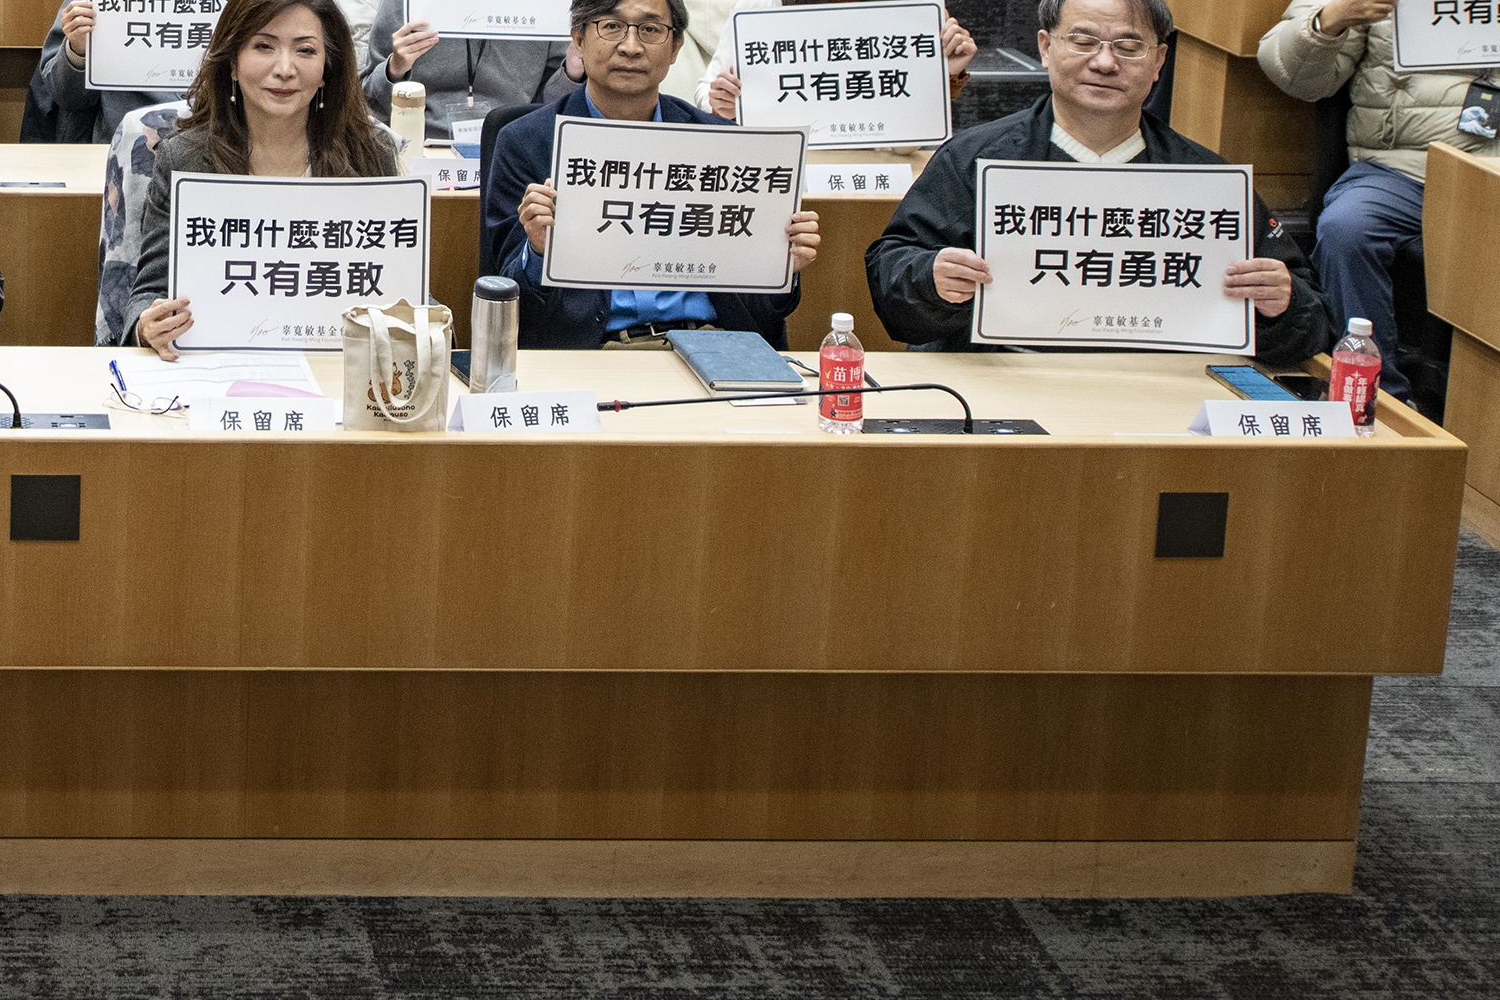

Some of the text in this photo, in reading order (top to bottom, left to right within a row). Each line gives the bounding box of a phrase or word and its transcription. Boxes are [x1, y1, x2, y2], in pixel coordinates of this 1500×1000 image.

[124, 22, 215, 52] 只有勇
[745, 34, 935, 65] 我們什麼都沒有
[778, 70, 910, 102] 只有勇敢
[566, 158, 793, 194] 我們什麼都沒有
[828, 174, 889, 190] 保留席
[186, 217, 418, 249] 我們什麼都沒有
[597, 200, 755, 237] 只有勇敢
[994, 204, 1239, 240] 我們什麼都沒有
[221, 260, 383, 297] 只有勇敢
[1030, 249, 1202, 288] 只有勇敢
[220, 410, 303, 431] 保留席
[491, 404, 569, 428] 保留席
[1238, 414, 1322, 437] 保留席
